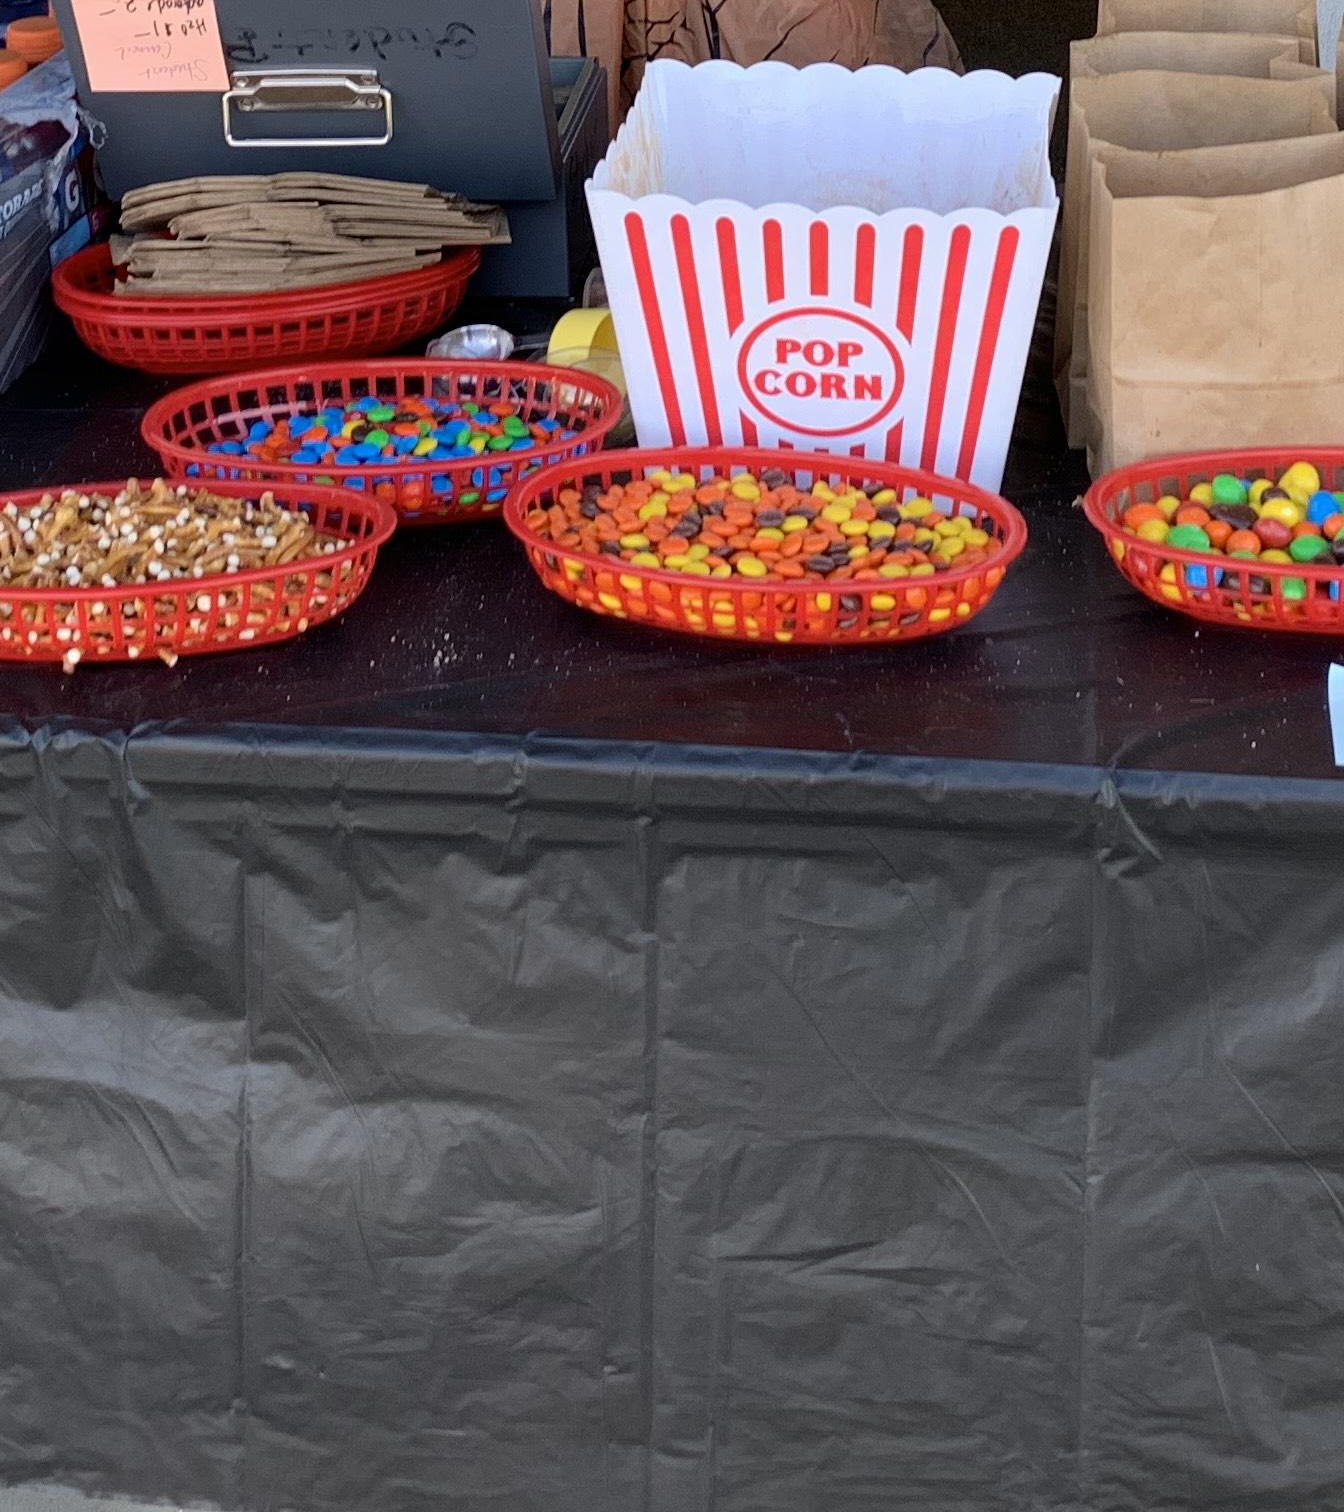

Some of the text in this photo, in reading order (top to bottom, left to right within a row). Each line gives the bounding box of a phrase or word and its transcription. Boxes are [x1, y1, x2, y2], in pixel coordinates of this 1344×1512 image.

[139, 59, 209, 82] Student
[775, 338, 864, 368] POP
[753, 369, 883, 401] CORN
